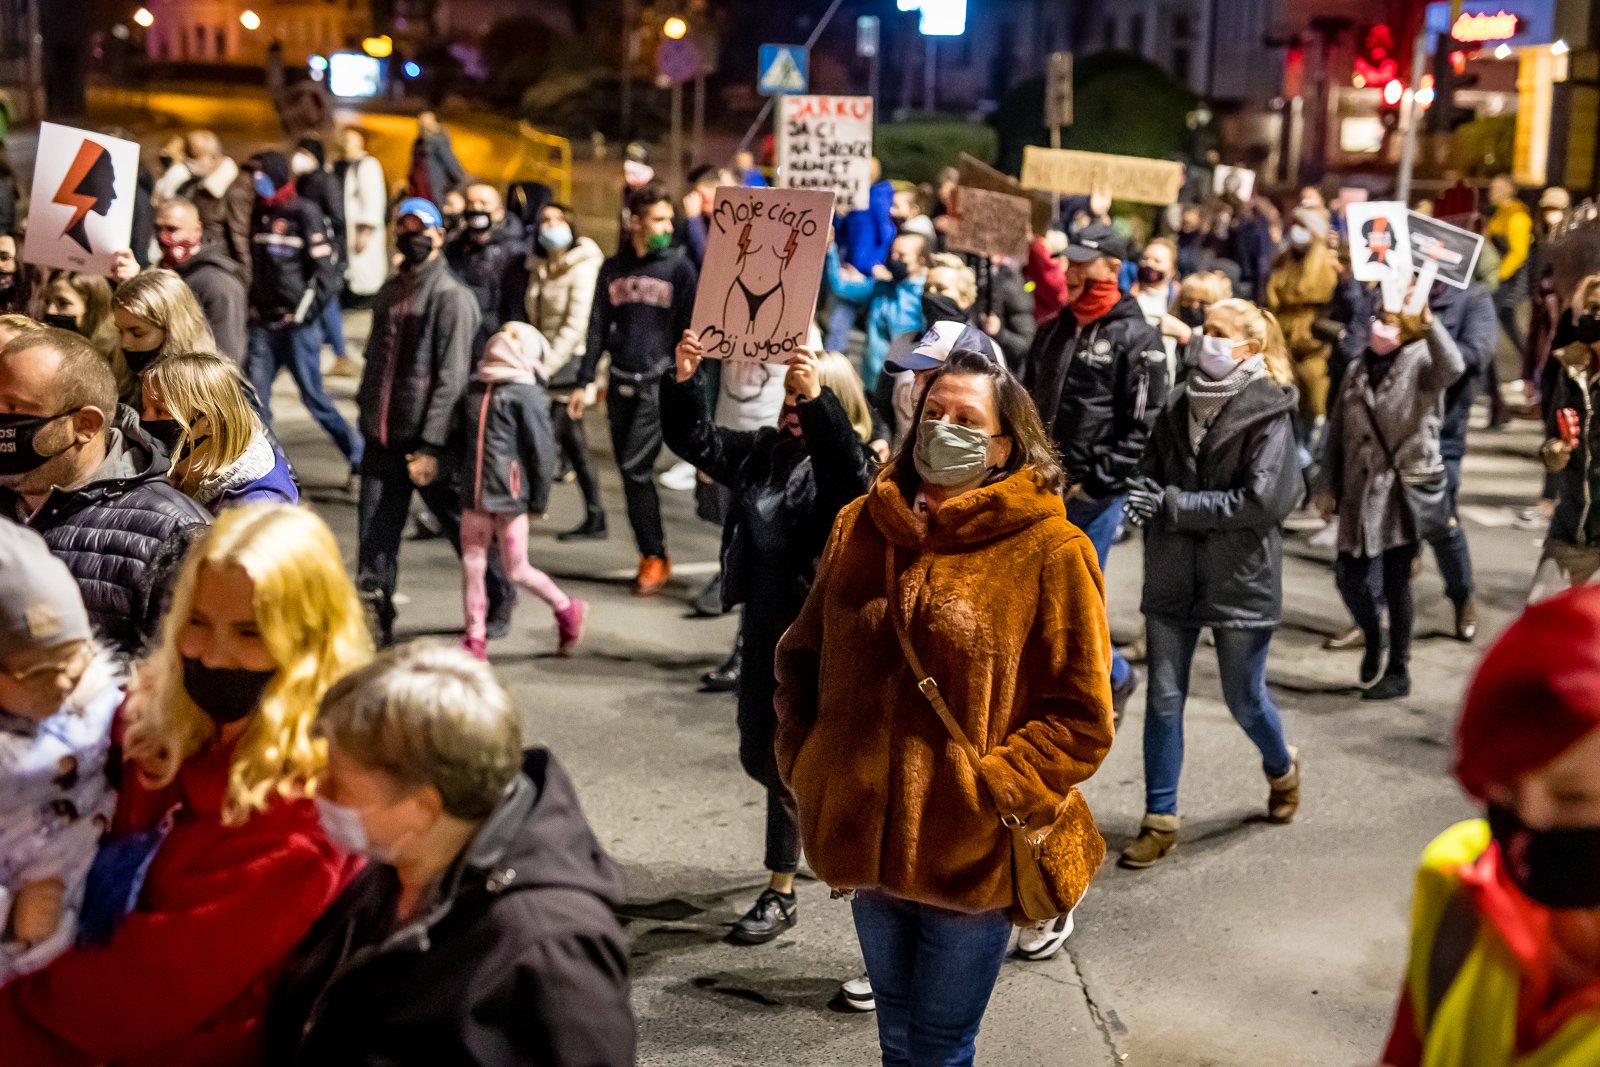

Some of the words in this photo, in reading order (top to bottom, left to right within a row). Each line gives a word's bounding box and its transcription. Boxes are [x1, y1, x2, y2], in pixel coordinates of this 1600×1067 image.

[713, 195, 764, 234] Moje
[698, 325, 739, 359] Mój
[743, 331, 803, 362] wybór
